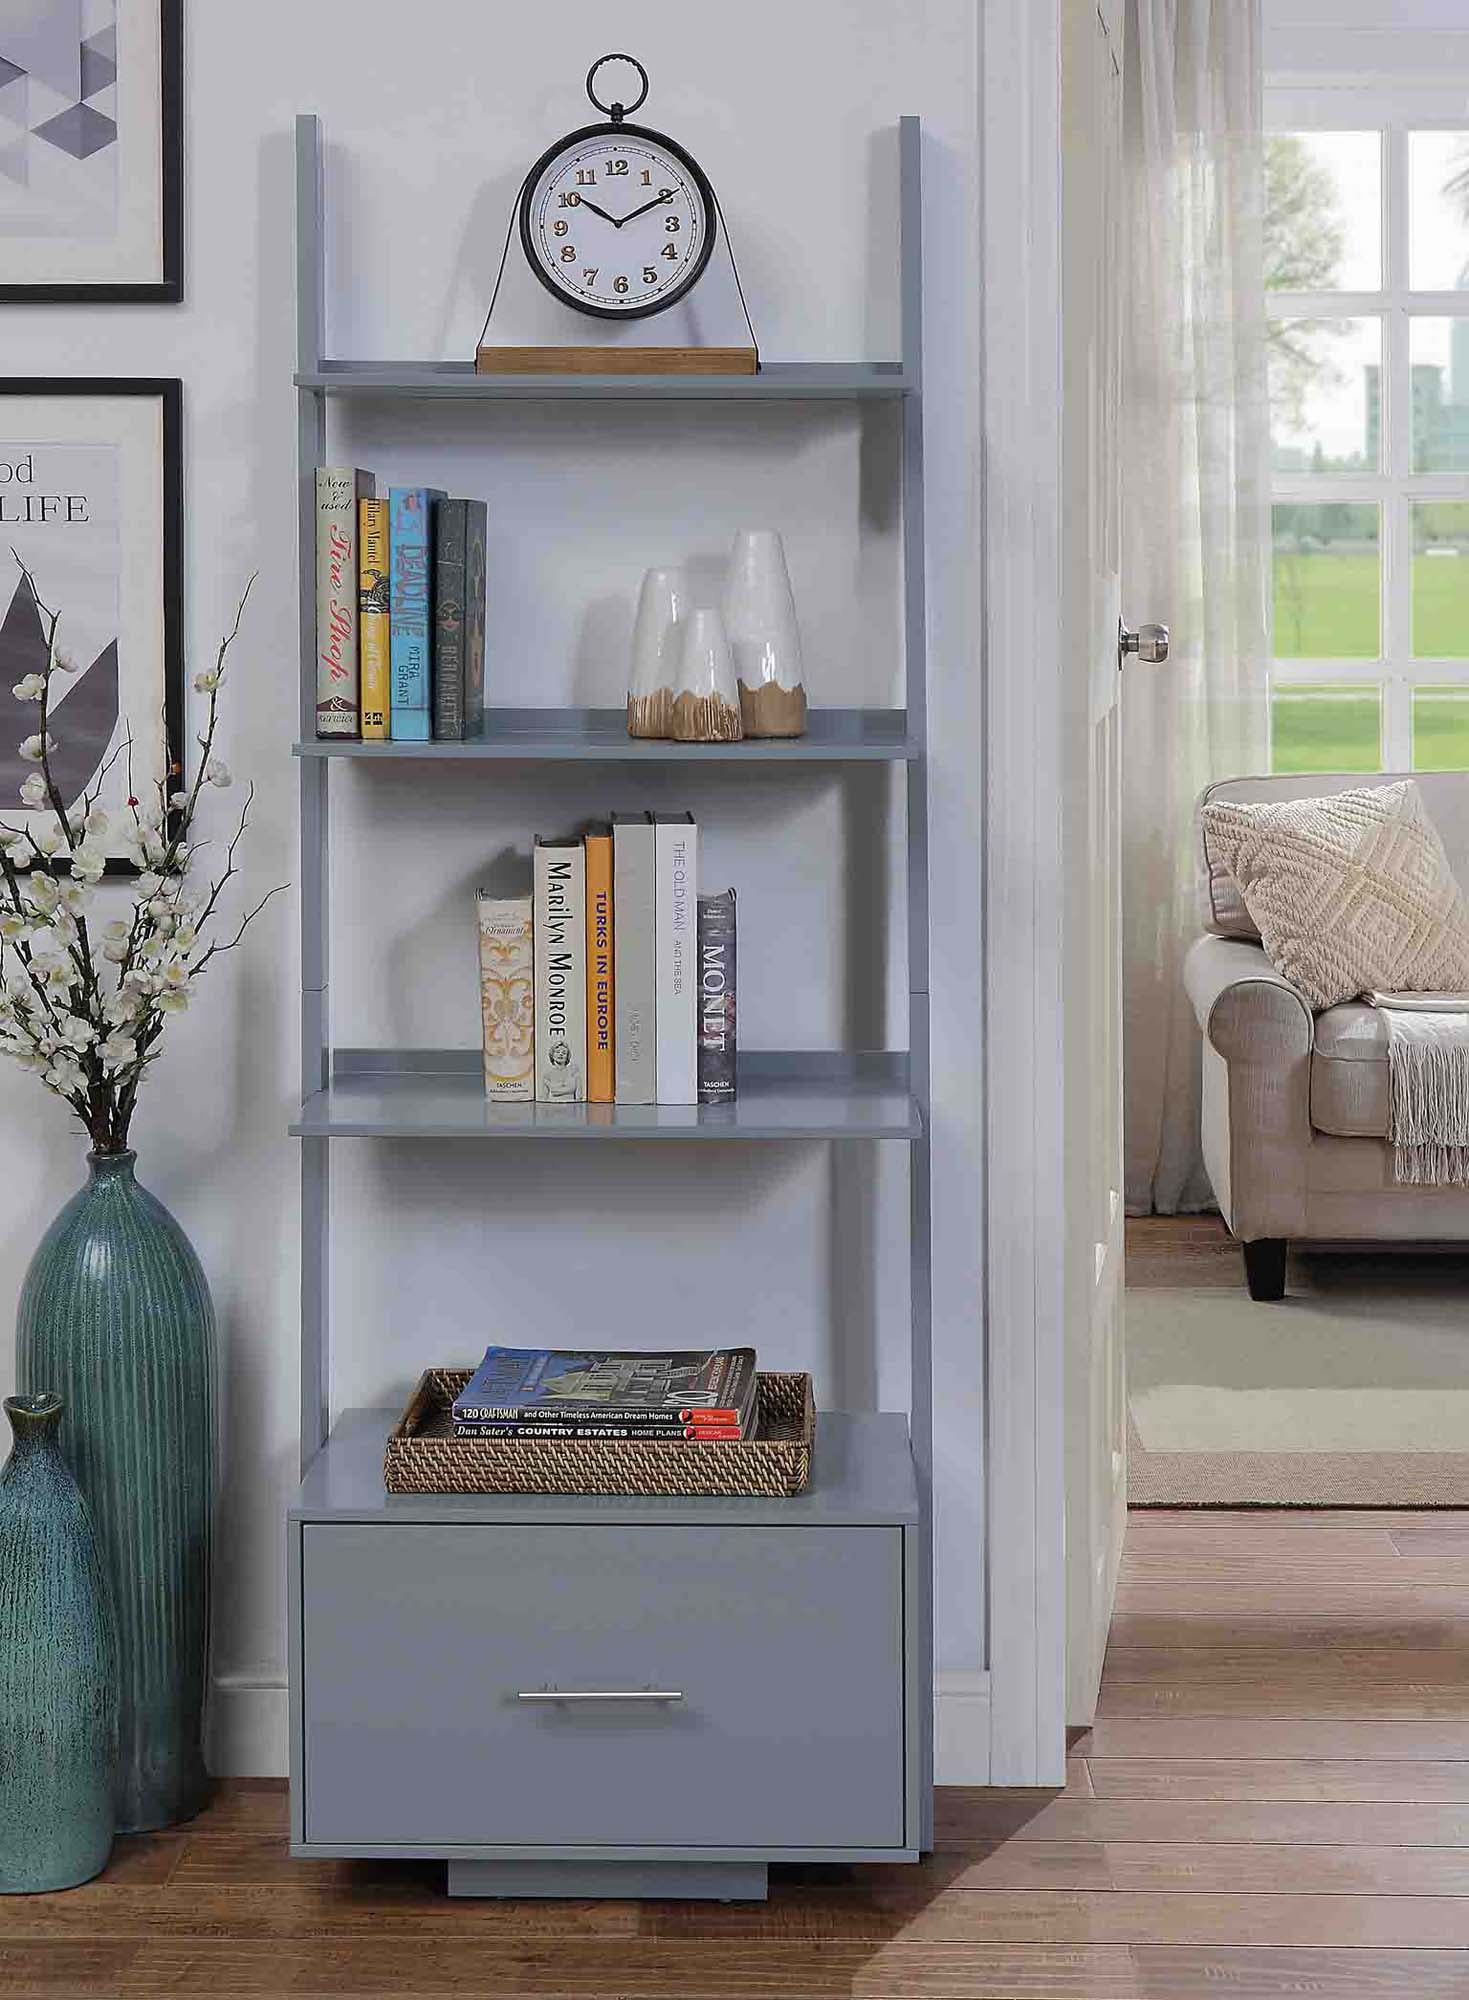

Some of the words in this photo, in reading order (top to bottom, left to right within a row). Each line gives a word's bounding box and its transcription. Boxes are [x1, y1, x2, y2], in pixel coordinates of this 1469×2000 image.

[605, 160, 629, 176] 12
[576, 170, 597, 185] 11
[640, 170, 652, 186] 1
[558, 192, 581, 208] 10
[658, 189, 674, 204] 2
[554, 221, 568, 236] 9
[665, 216, 680, 232] 3
[561, 245, 576, 262] 8
[661, 243, 678, 260] 4
[583, 268, 599, 286] 7
[642, 267, 657, 283] 5
[613, 276, 629, 293] 6
[0, 496, 89, 521] LIFE
[321, 499, 352, 511] used
[367, 531, 381, 564] Mantel
[409, 646, 421, 679] MIRA
[397, 665, 410, 705] GRANT
[330, 696, 348, 712] &
[673, 841, 686, 867] THE
[673, 870, 686, 898] OLD
[595, 891, 608, 948] TURKS
[673, 901, 686, 931] MAN
[596, 954, 607, 975] IN
[674, 977, 682, 995] SEA
[549, 953, 573, 1037] MONROE
[702, 944, 727, 1051] MONET
[597, 982, 609, 1050] EUROPE
[462, 1408, 479, 1419] 120
[480, 1407, 519, 1419] CRAFTSMAN
[560, 1411, 589, 1419] Timeless
[590, 1411, 623, 1419] American
[624, 1412, 648, 1420] Dream
[649, 1412, 673, 1420] Homes
[457, 1426, 477, 1436] Dan
[480, 1426, 513, 1436] Sater's
[517, 1427, 574, 1436] COUNTRY
[577, 1428, 628, 1437] ESTATES
[631, 1429, 653, 1437] HOME
[656, 1430, 682, 1438] PLANS
